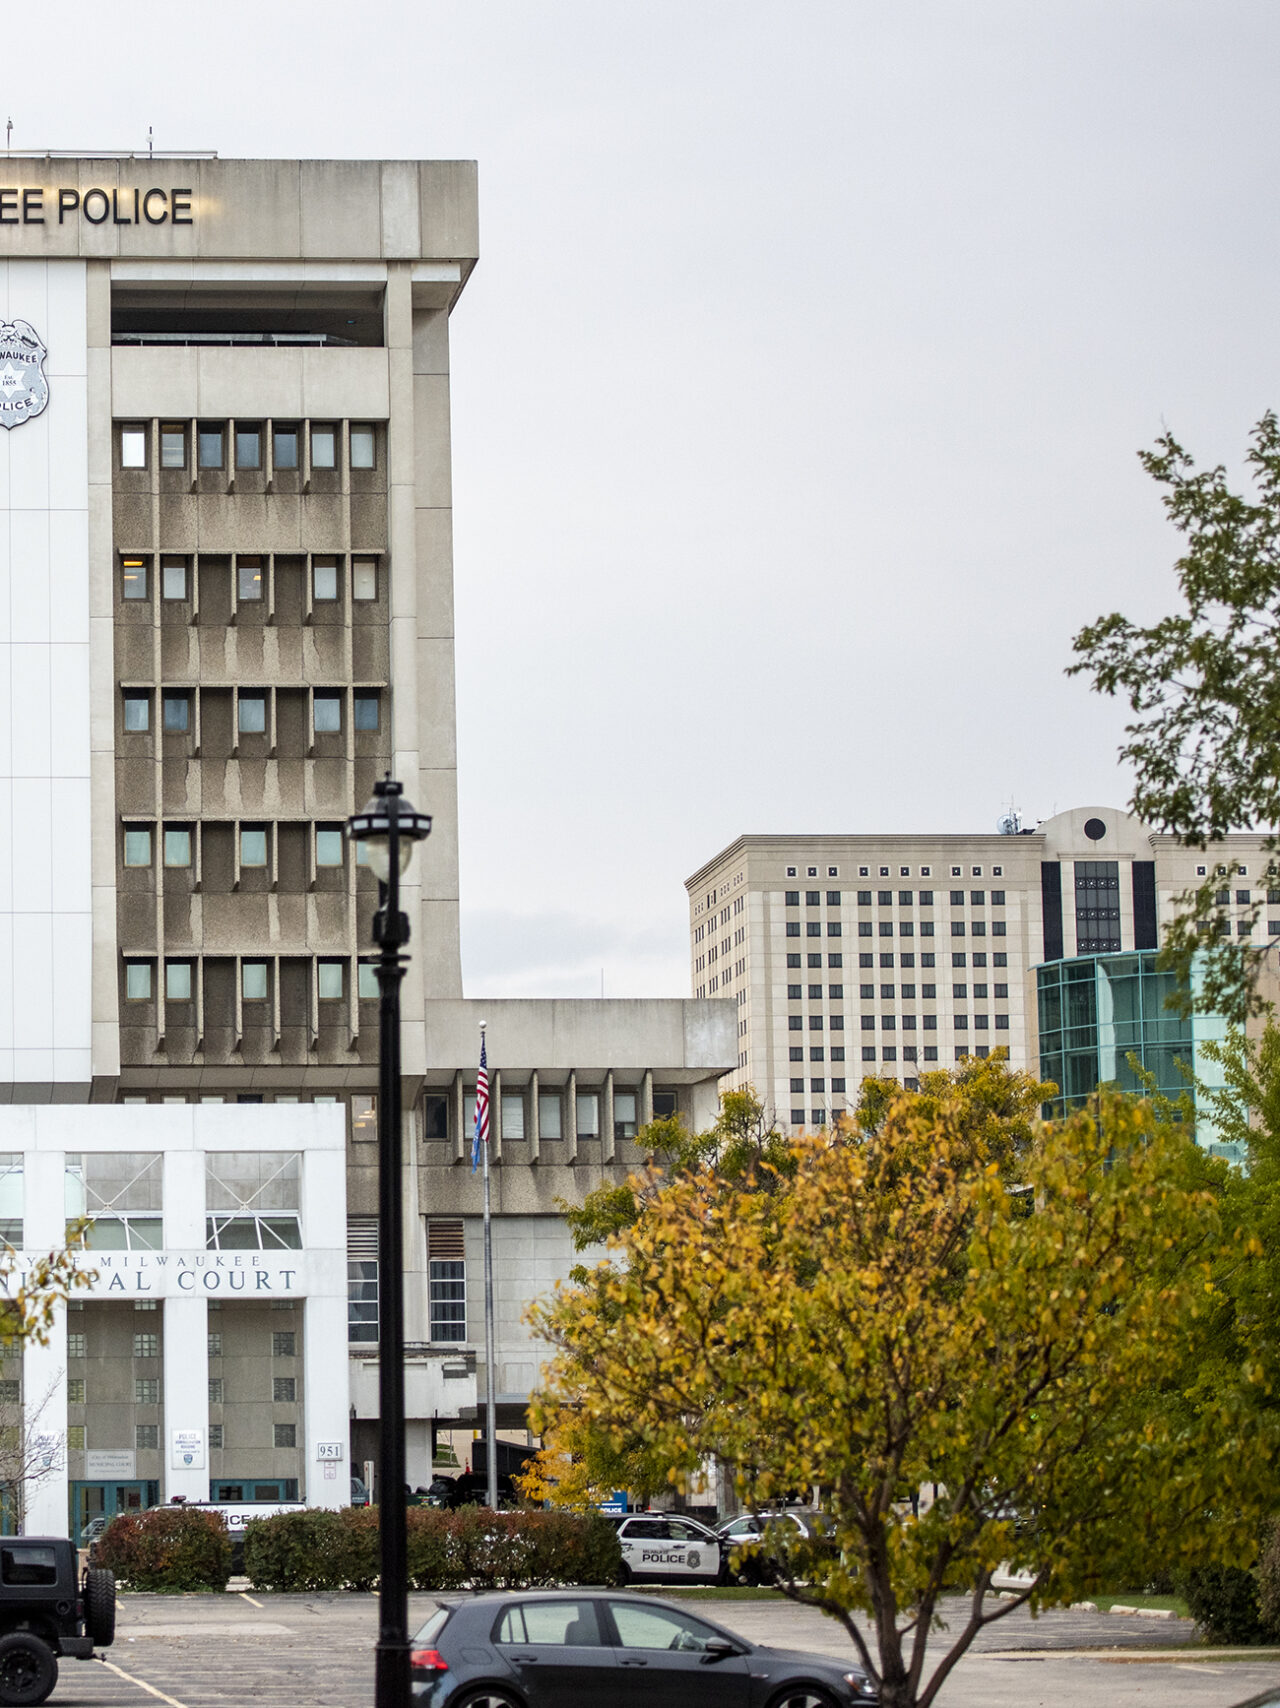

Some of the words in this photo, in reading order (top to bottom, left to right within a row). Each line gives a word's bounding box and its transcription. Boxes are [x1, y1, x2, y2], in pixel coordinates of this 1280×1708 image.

[58, 187, 193, 225] POLICE
[100, 1256, 261, 1267] MILWAUKEE
[177, 1271, 296, 1290] COURT
[320, 1446, 338, 1457] 951
[642, 1554, 686, 1563] POLICE
